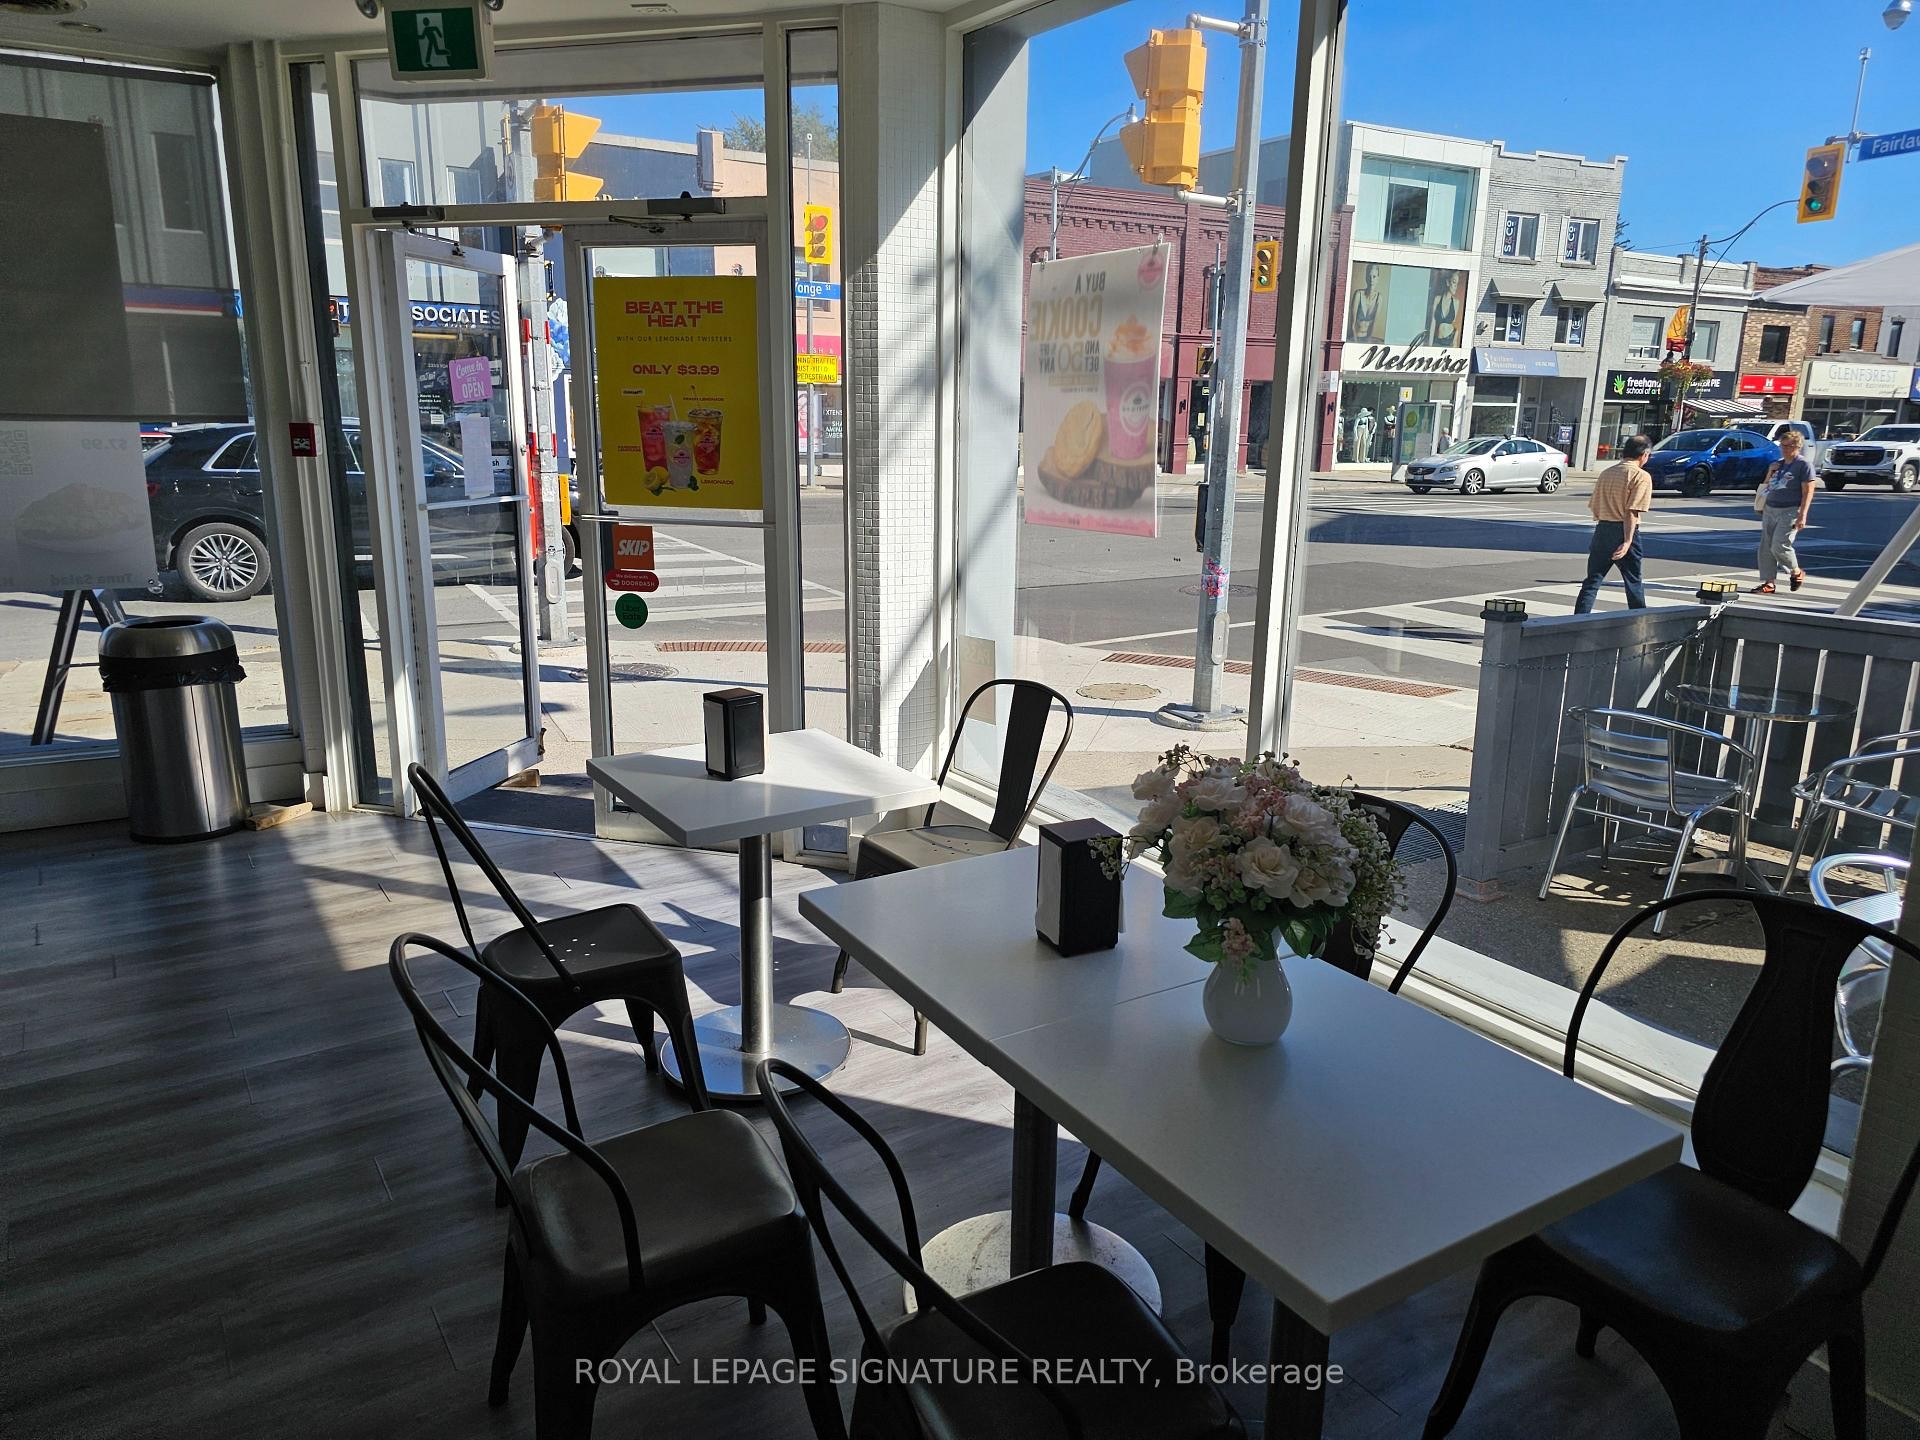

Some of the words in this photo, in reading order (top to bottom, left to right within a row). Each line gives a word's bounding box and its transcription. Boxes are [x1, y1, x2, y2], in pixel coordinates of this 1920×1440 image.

[625, 301, 677, 314] BEAT
[683, 301, 723, 314] THE
[648, 315, 702, 328] HEAT
[1359, 330, 1468, 373] Nelmira
[632, 364, 673, 375] ONLY
[677, 364, 721, 376] $3.99
[462, 381, 486, 398] OPEN
[617, 540, 650, 556] SKIP
